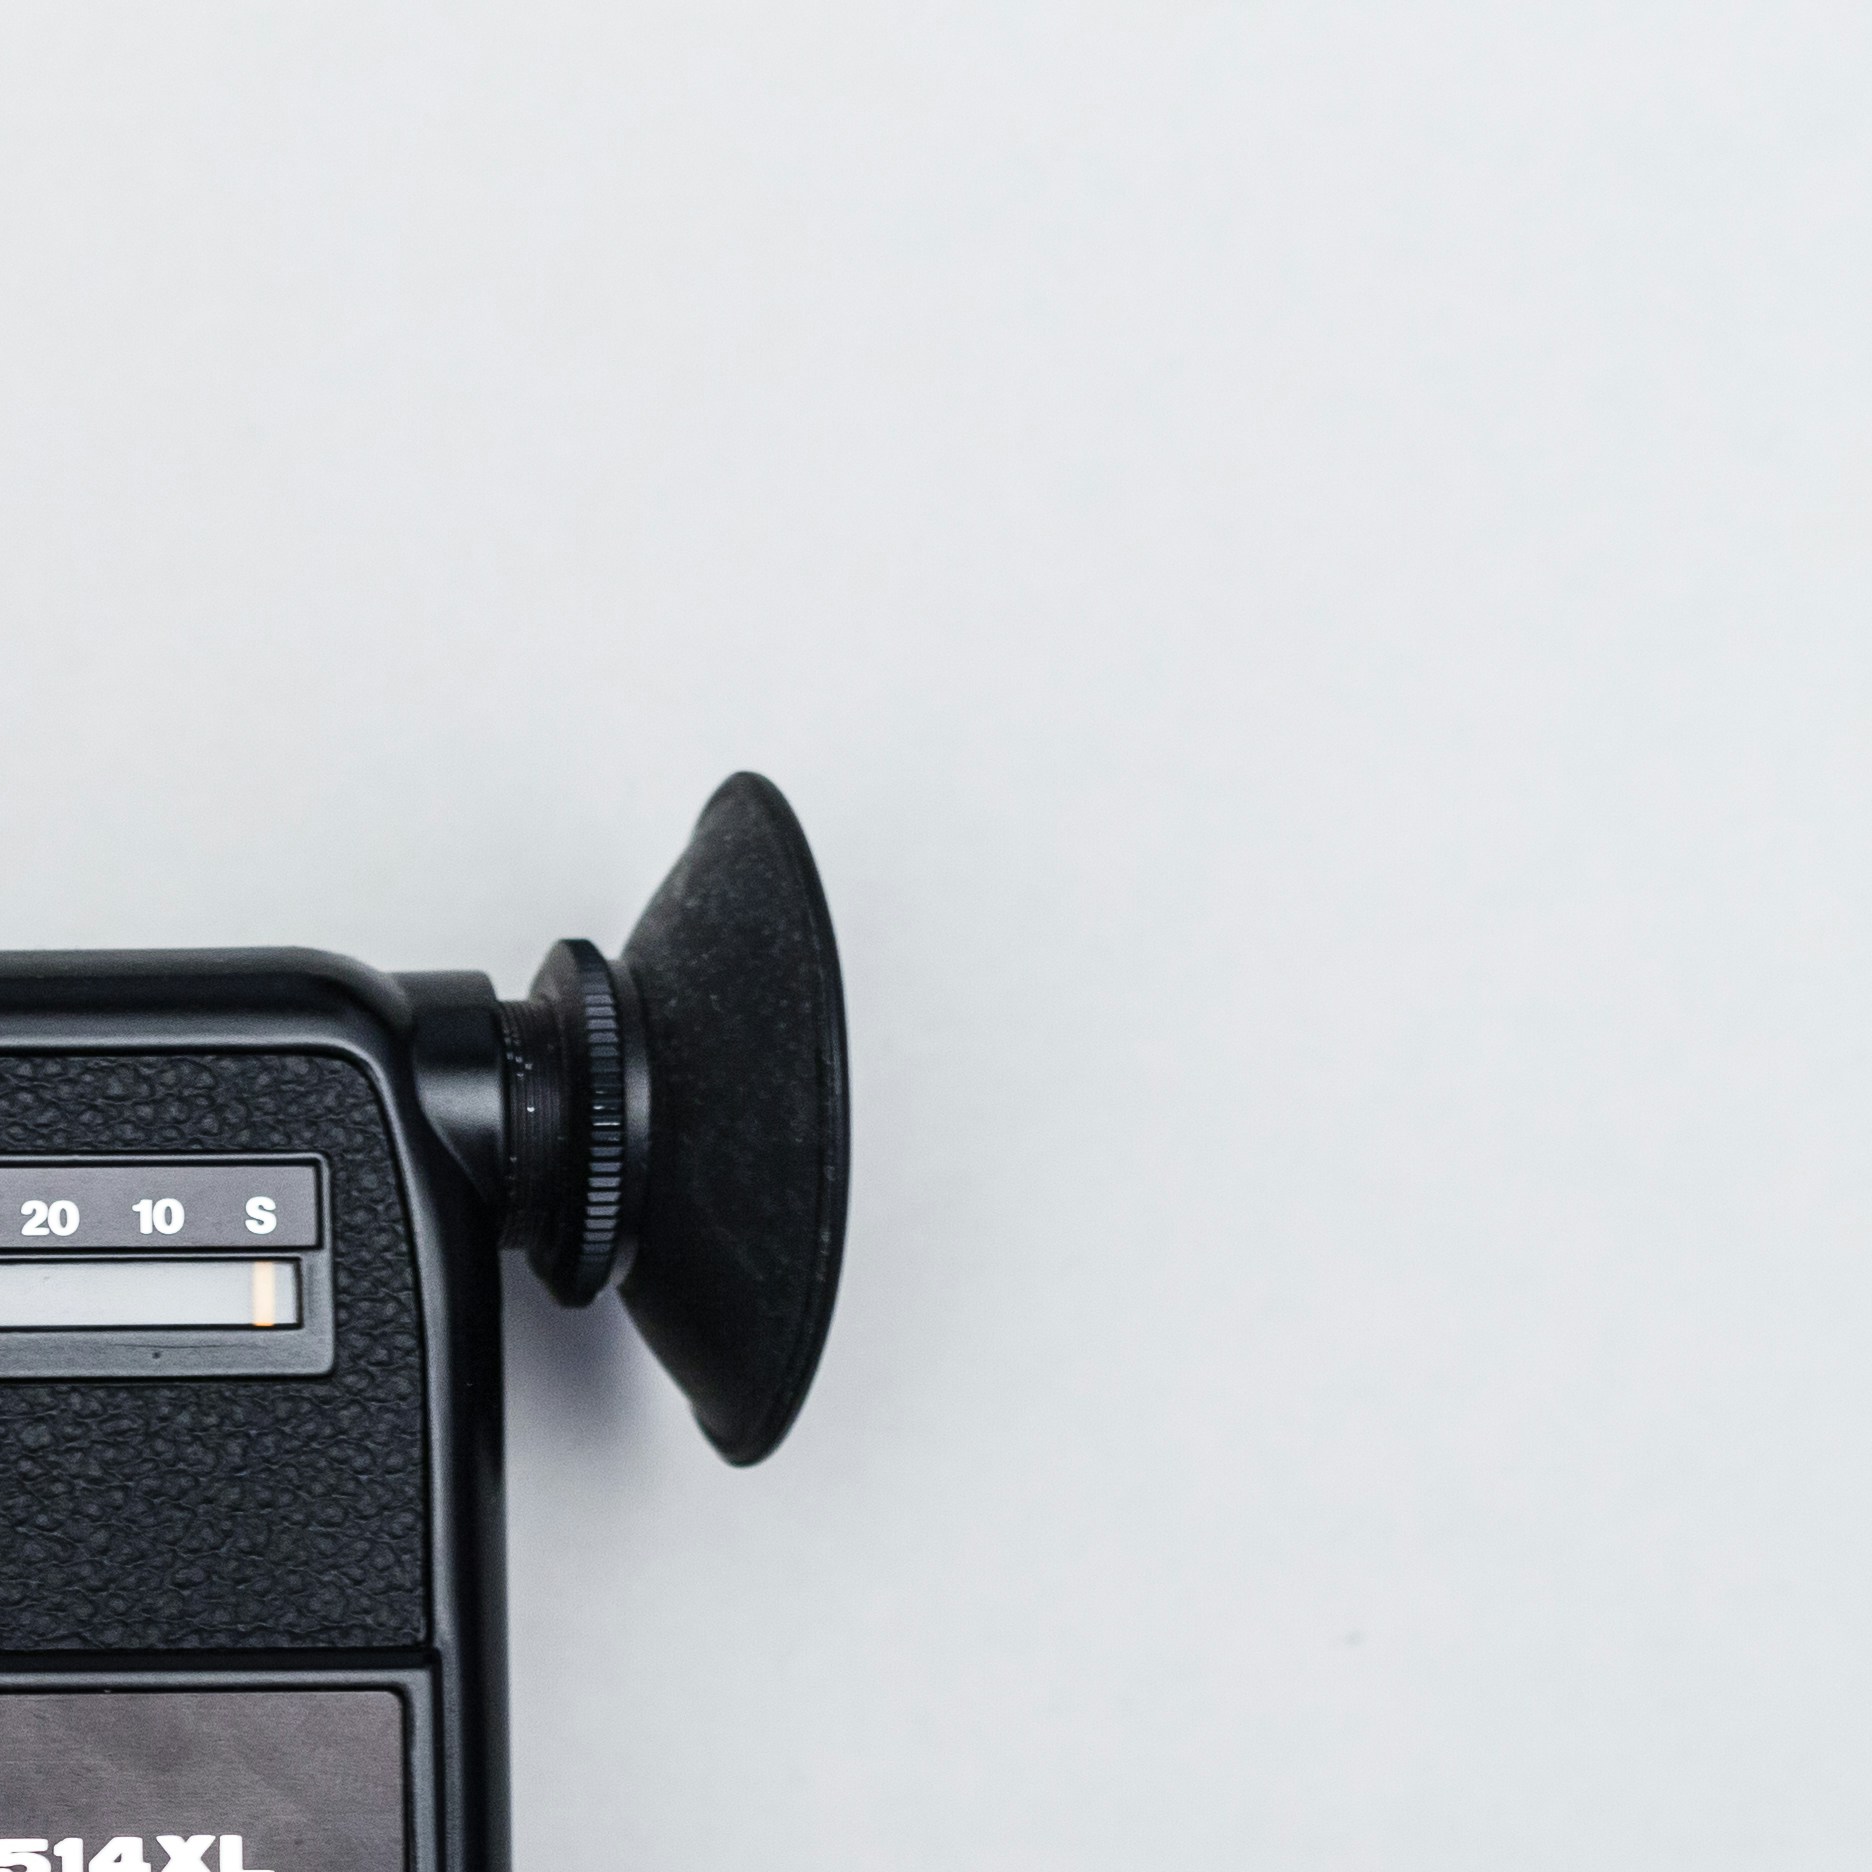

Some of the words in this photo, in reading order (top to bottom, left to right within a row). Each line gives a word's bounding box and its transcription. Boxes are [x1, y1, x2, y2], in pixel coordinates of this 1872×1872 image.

[19, 1199, 81, 1238] 20
[131, 1197, 186, 1236] 10
[244, 1196, 278, 1235] S
